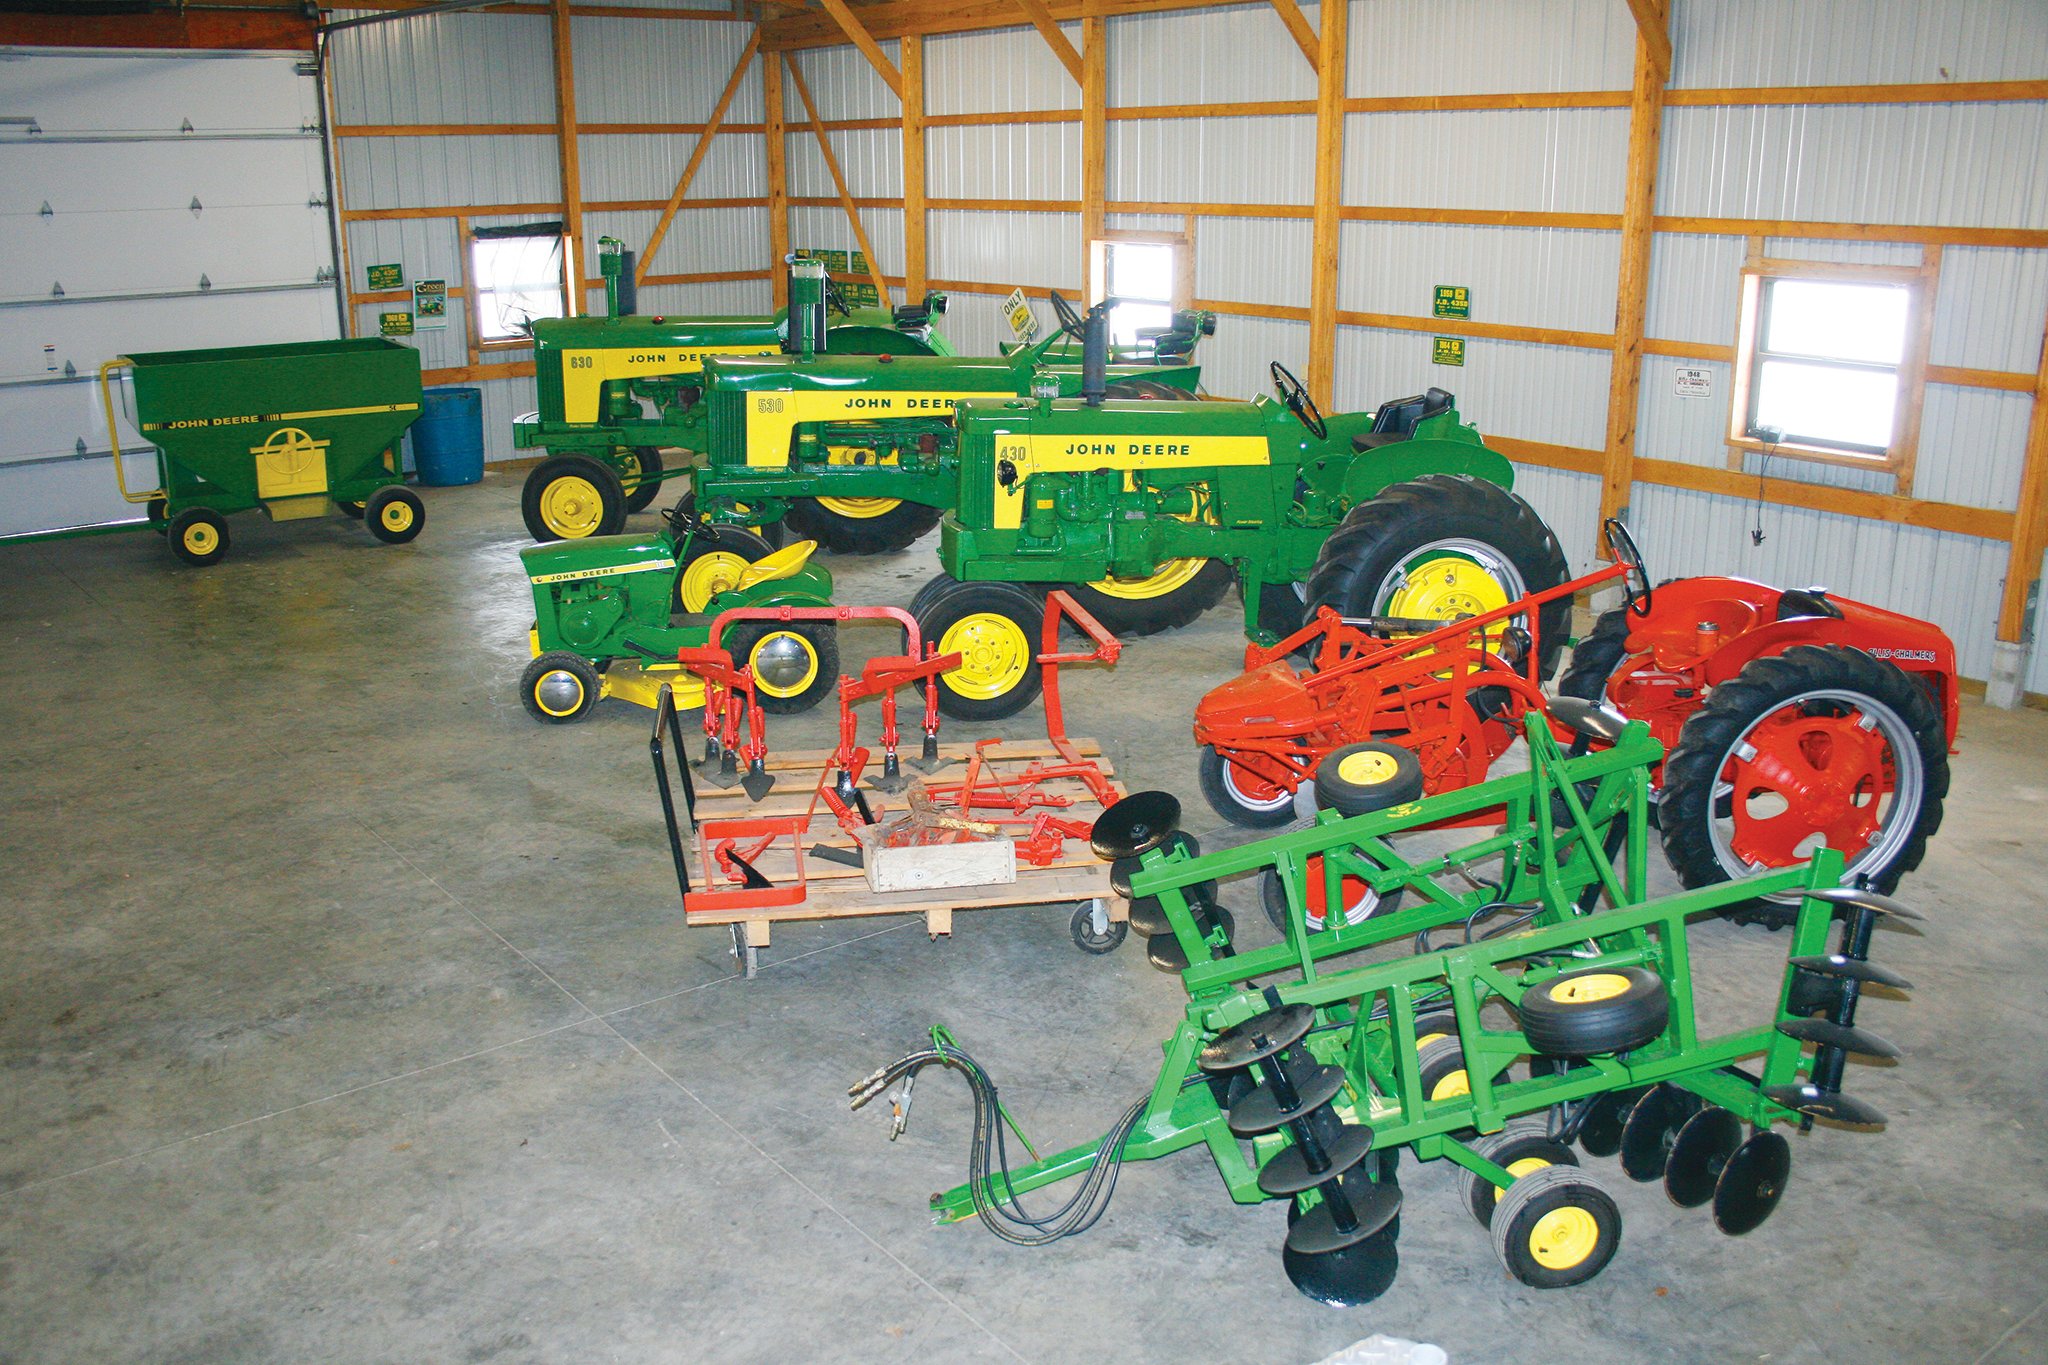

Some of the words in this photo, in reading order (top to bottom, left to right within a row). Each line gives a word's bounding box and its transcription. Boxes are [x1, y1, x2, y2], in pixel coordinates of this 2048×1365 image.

[417, 283, 445, 293] Green
[1004, 291, 1021, 315] ONLY
[571, 356, 593, 369] 630
[628, 354, 666, 363] JOHN
[758, 398, 784, 413] 530
[845, 398, 892, 408] JOHN
[907, 399, 956, 409] DEER
[168, 419, 209, 430] JOHN
[212, 415, 260, 426] DEERE
[1000, 446, 1026, 461] 430
[1065, 444, 1116, 455] JOHN
[1129, 444, 1190, 455] DEERE
[550, 573, 576, 582] JOHN
[582, 568, 616, 577] DEERE
